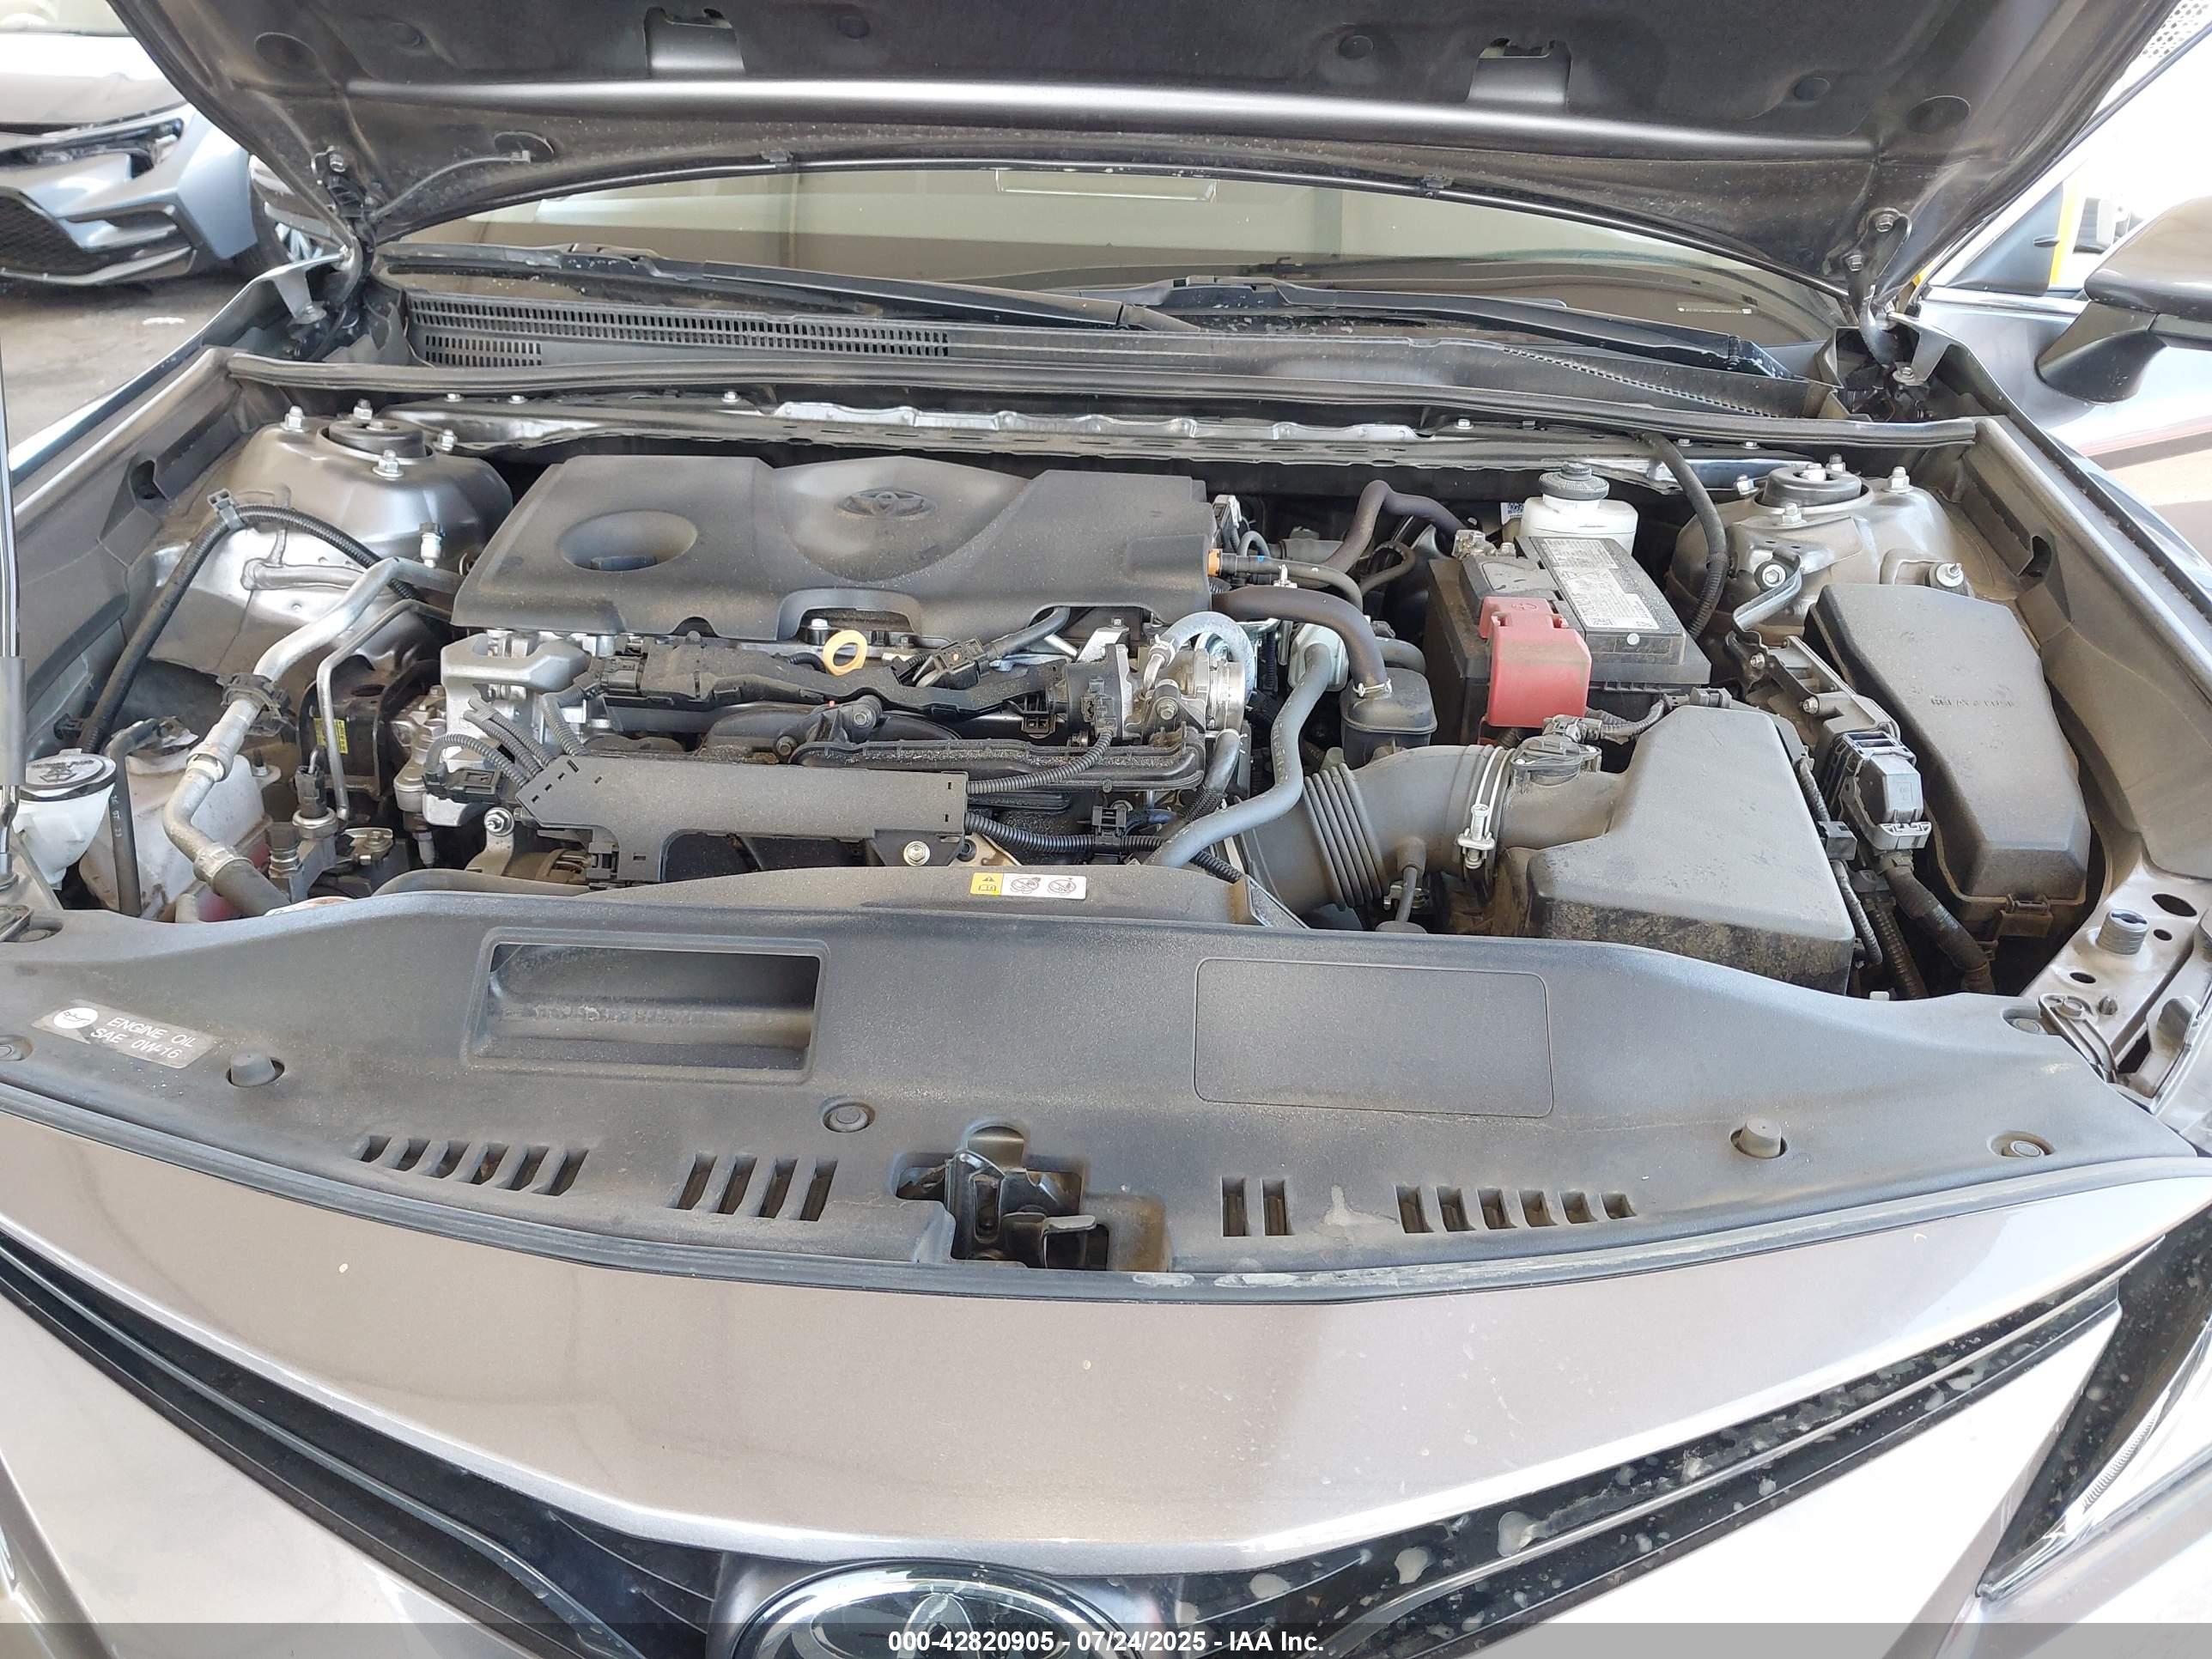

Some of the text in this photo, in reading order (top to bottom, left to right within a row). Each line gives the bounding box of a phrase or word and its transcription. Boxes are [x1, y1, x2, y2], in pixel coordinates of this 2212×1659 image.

[90, 1028, 182, 1059] SAE 0W-16
[107, 1018, 197, 1048] ENGINE OIL
